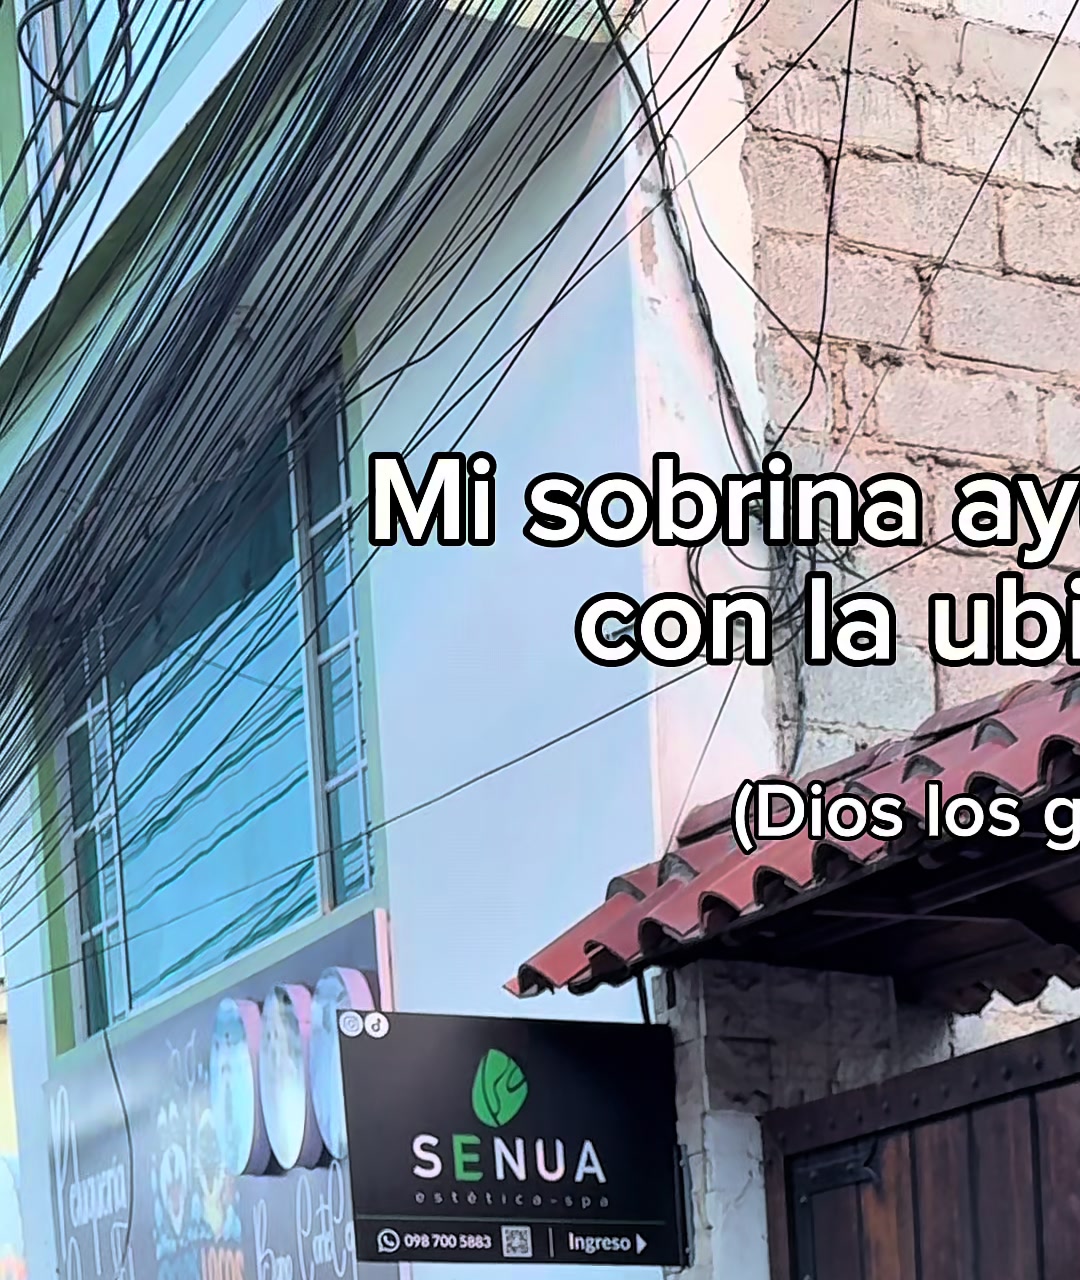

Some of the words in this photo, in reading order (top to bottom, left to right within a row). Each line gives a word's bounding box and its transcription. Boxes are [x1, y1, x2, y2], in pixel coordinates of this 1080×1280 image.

[411, 1133, 608, 1184] SENUA
[403, 1233, 430, 1248] 098
[431, 1234, 457, 1249] 700
[568, 1231, 632, 1254] Ingreso
